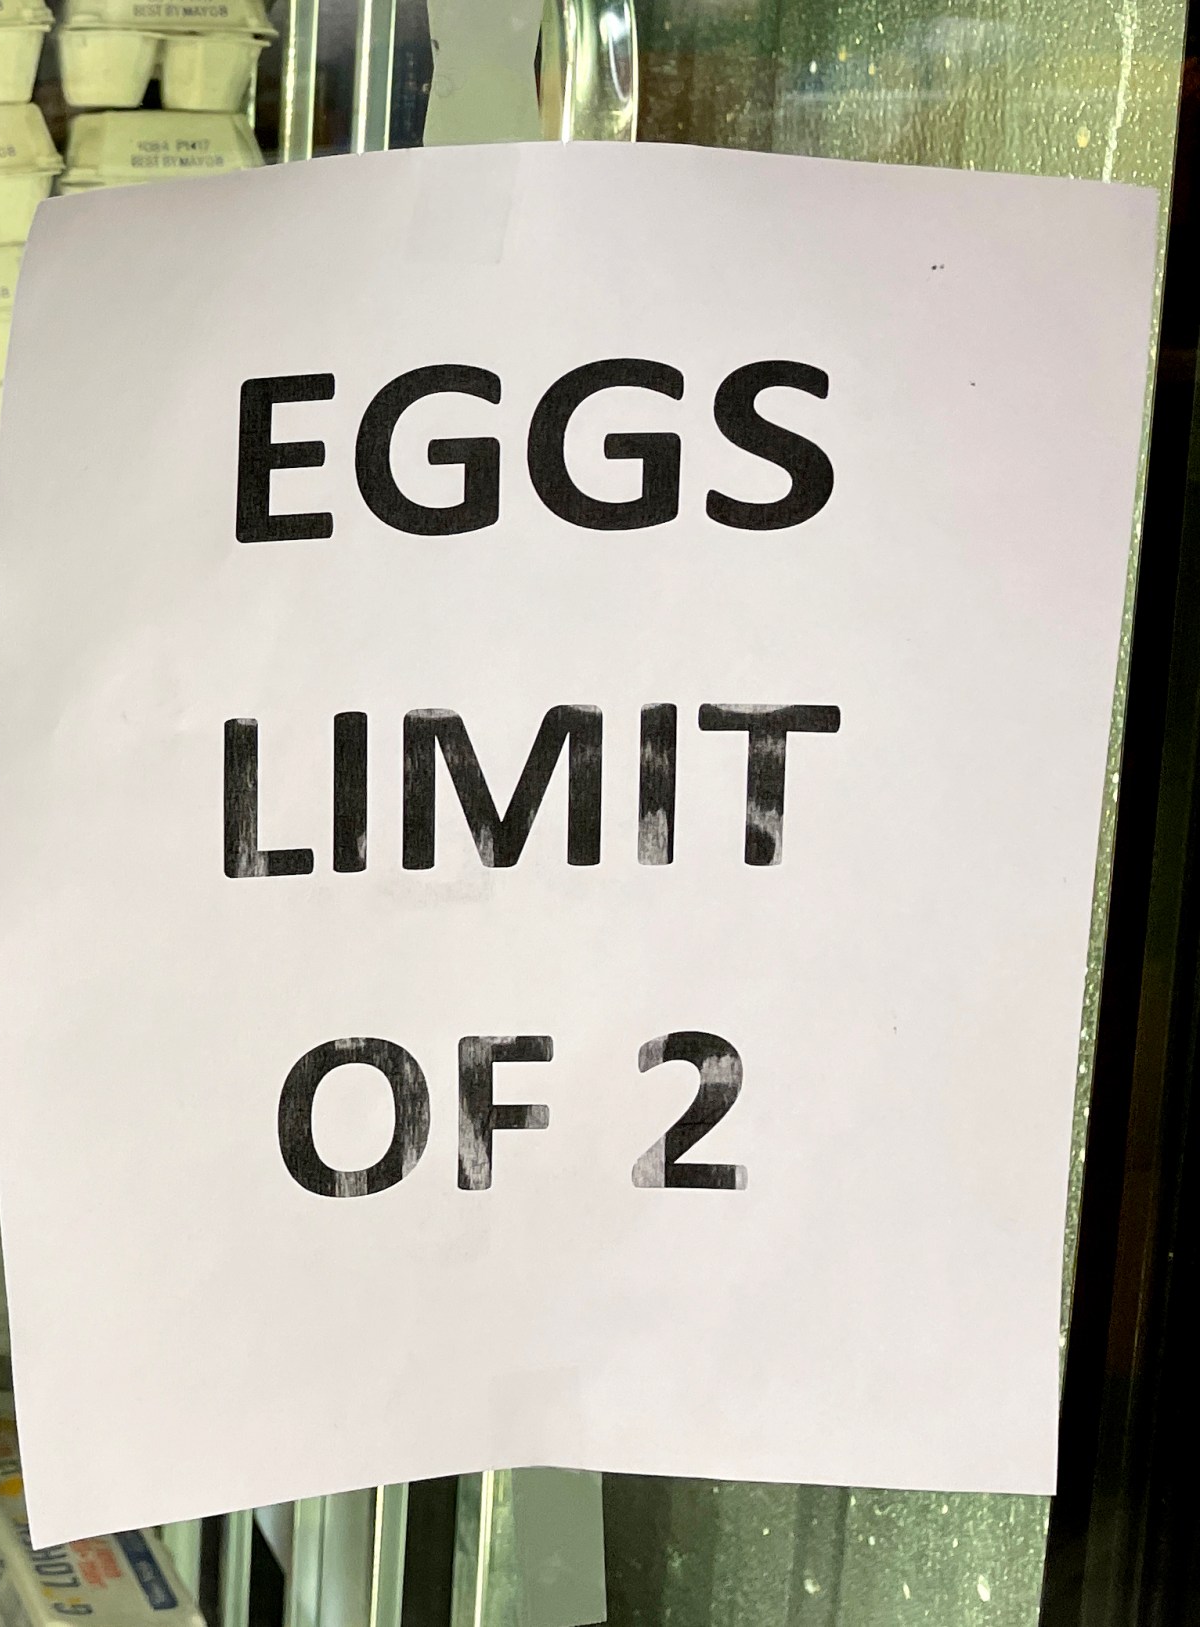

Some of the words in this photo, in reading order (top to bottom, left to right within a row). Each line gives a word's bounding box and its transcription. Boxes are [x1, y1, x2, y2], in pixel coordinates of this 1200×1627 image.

[133, 5, 162, 17] BEST
[130, 155, 159, 168] BEST
[235, 357, 835, 543] EGGS
[223, 702, 841, 879] LIMIT
[278, 1035, 554, 1198] OF
[631, 1030, 748, 1190] 2
